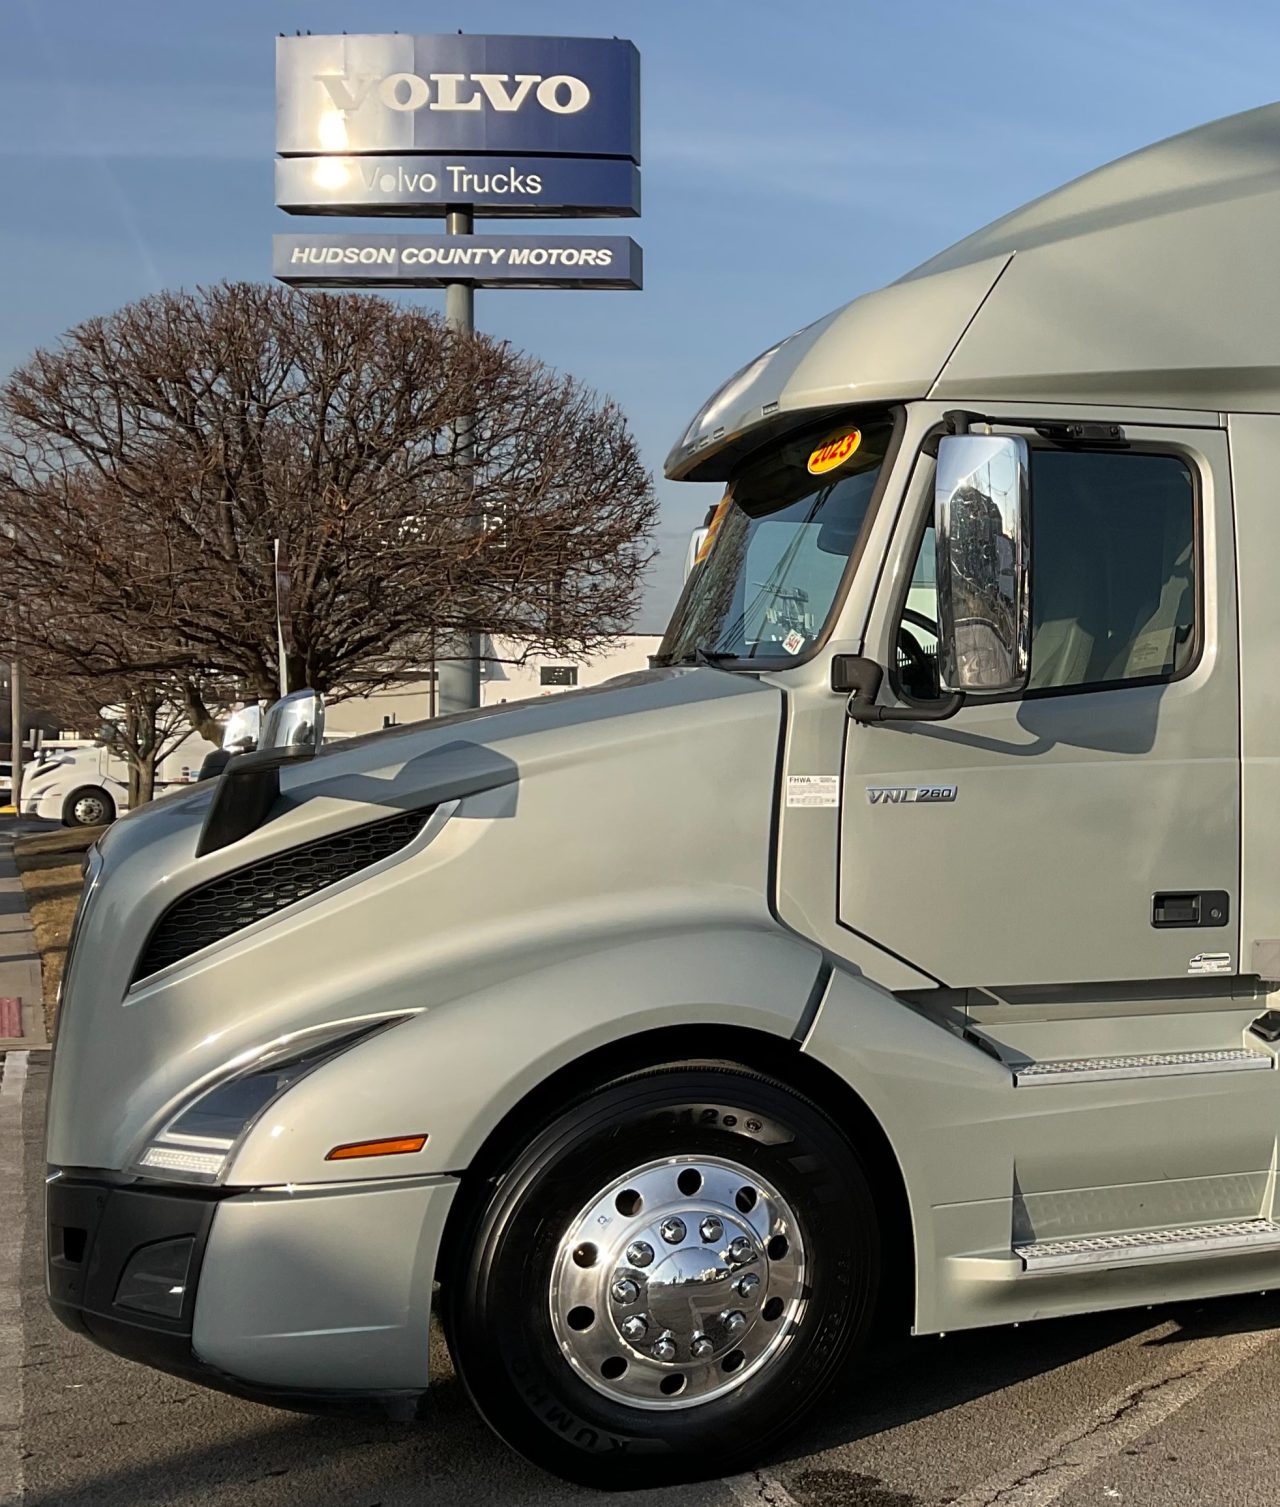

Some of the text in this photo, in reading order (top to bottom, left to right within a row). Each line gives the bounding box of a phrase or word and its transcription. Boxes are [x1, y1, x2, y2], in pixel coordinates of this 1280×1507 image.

[314, 72, 591, 114] VOLVO
[360, 166, 543, 194] Volvo Trucks
[290, 247, 613, 267] HUDSON COUNTY MOTORS
[811, 431, 857, 466] 2023
[867, 788, 952, 804] VNL 760
